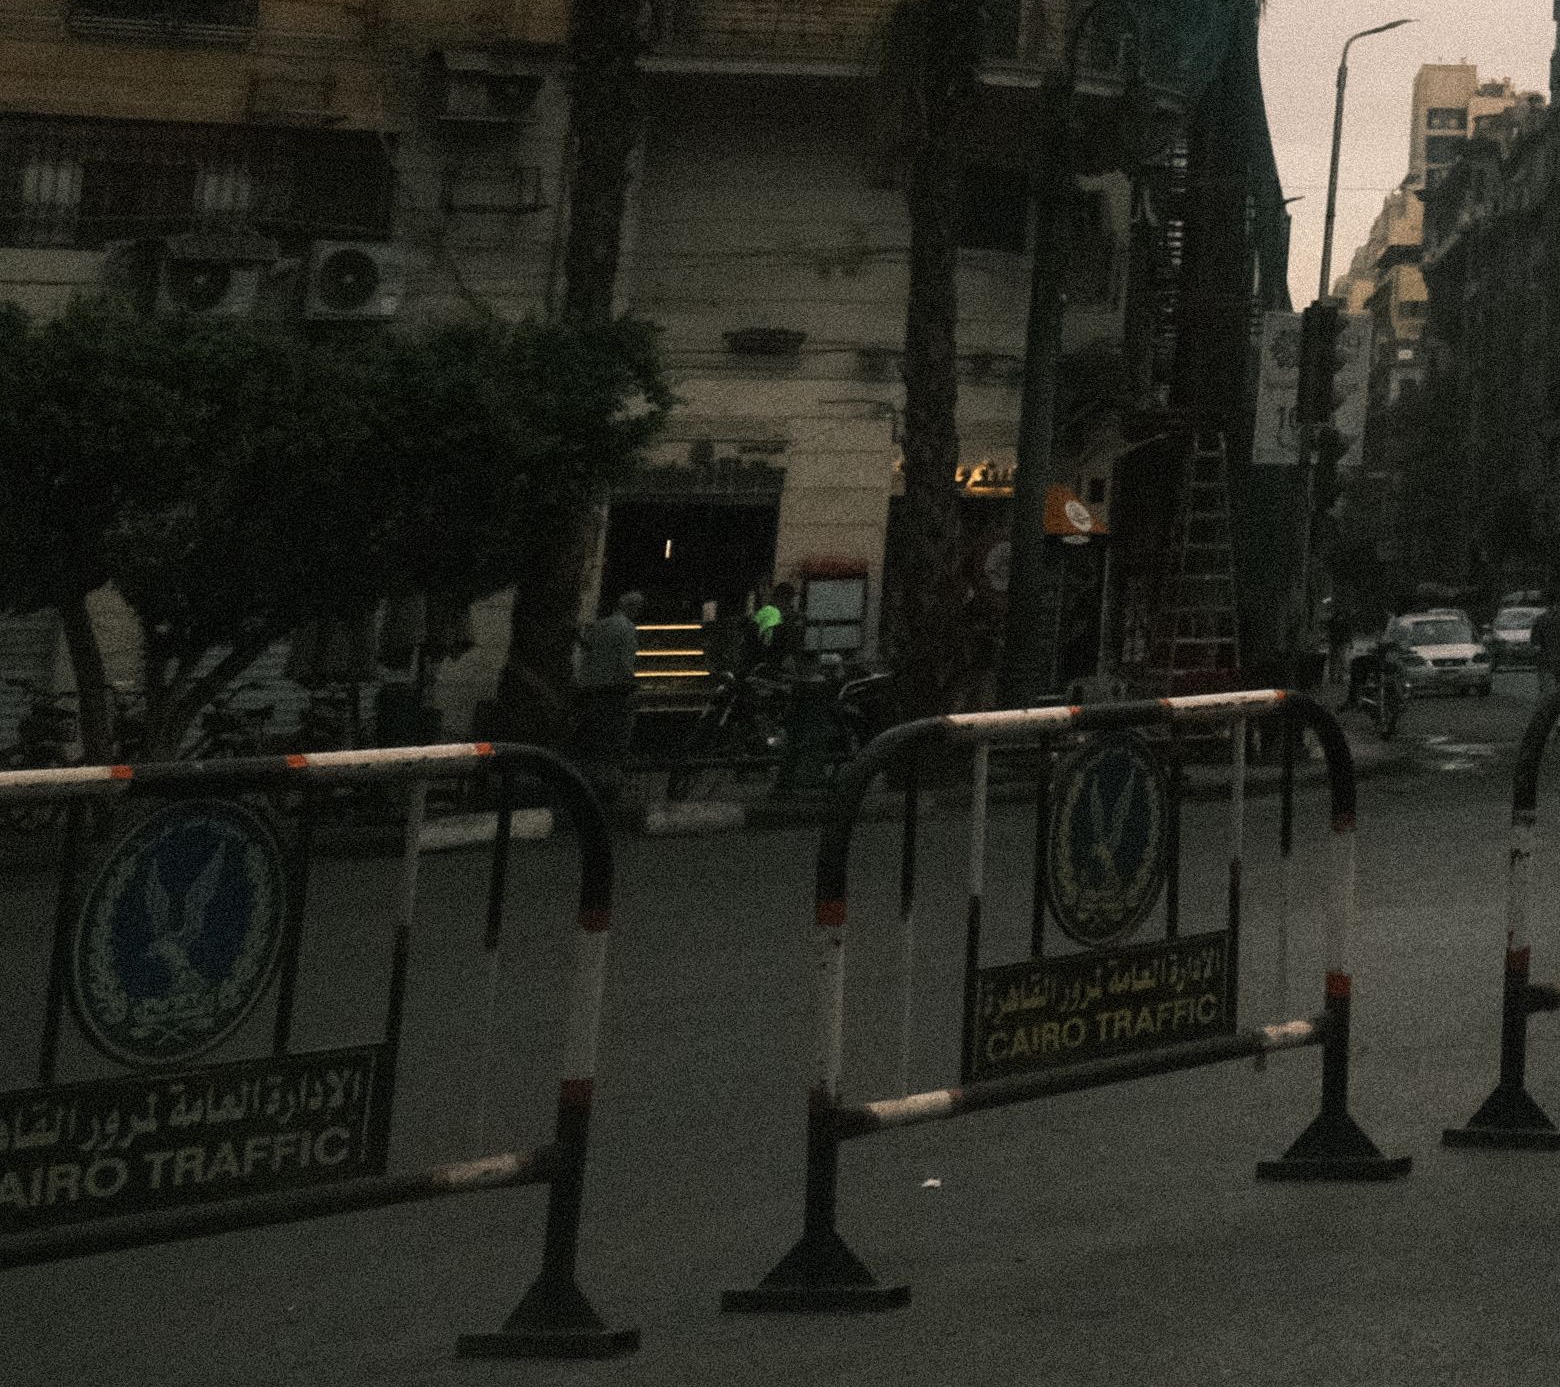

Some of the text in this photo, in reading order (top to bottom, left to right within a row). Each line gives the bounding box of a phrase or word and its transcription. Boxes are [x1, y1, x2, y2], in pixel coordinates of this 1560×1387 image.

[984, 992, 1218, 1063] CAIRO TRAFFIC
[0, 1126, 352, 1208] AIRO TRAFFIC
